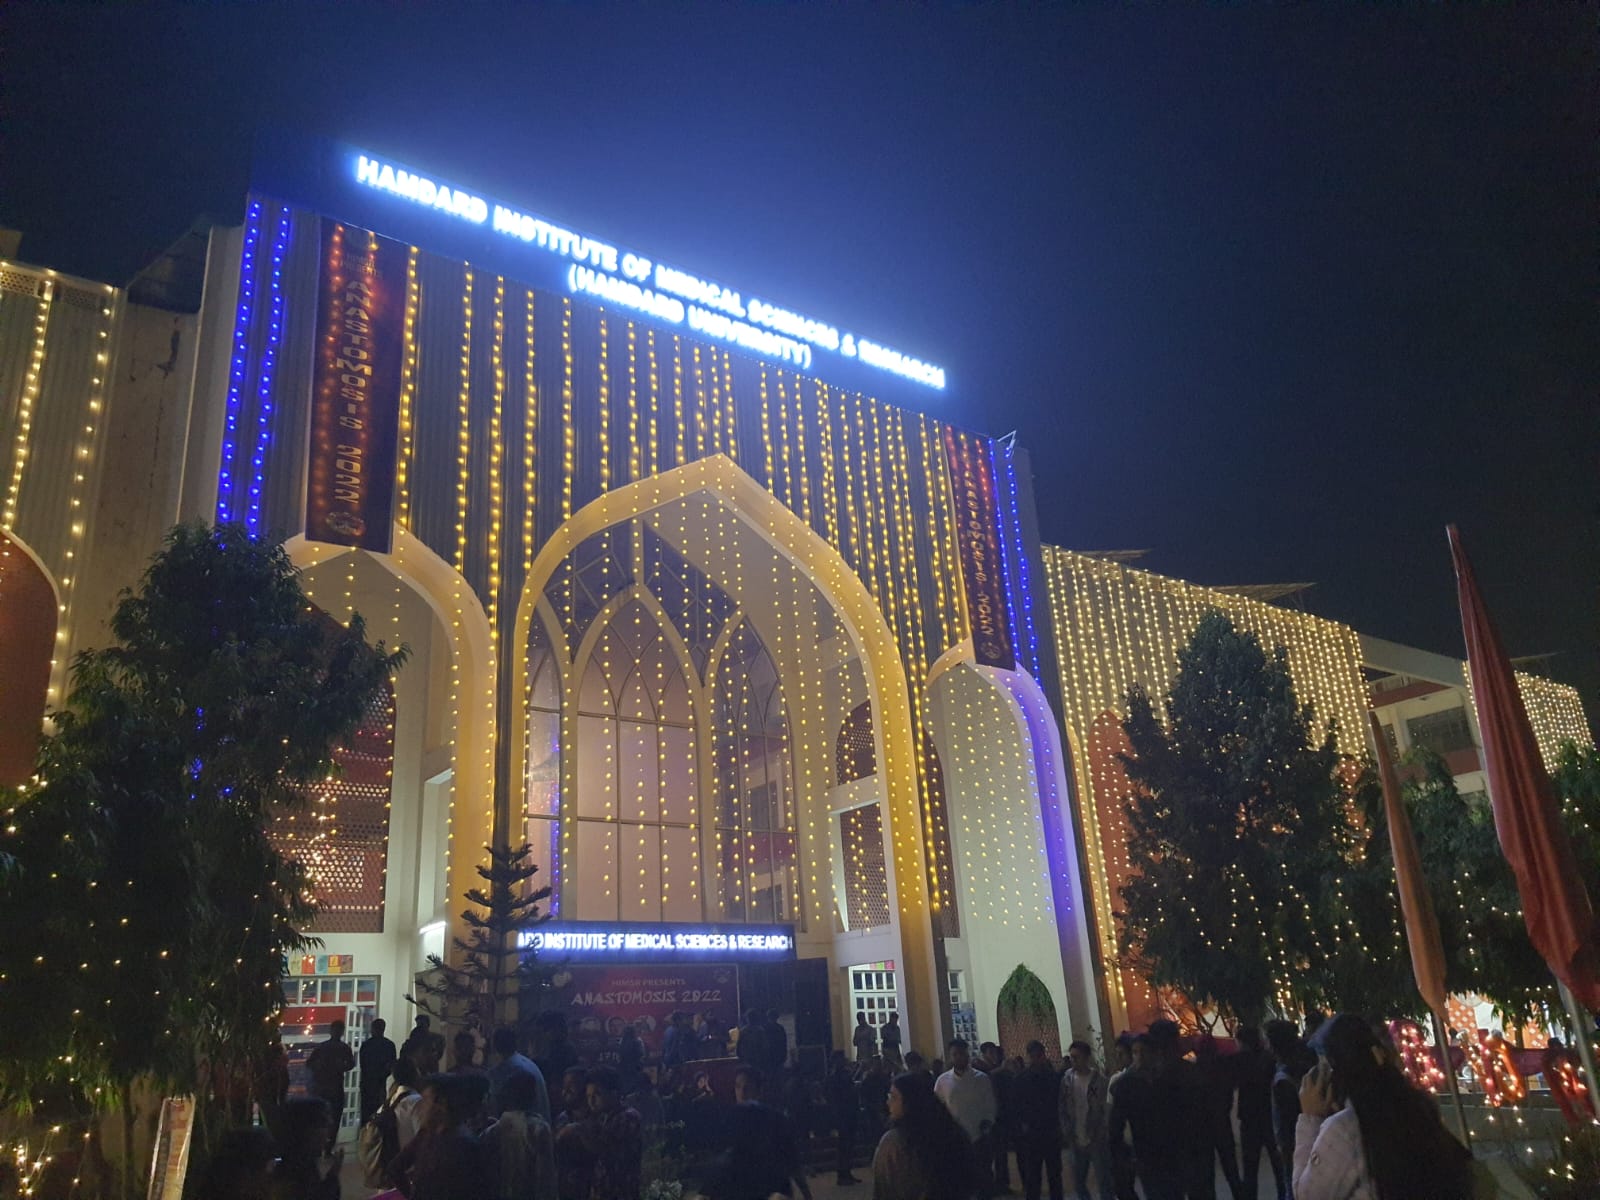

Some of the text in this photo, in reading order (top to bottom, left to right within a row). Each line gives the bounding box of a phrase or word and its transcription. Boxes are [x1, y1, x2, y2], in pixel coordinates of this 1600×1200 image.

[356, 155, 488, 224] HAMDARD
[493, 204, 618, 272] INSTITUTE
[621, 252, 652, 282] OF
[840, 333, 857, 357] &
[544, 932, 607, 950] INSTITUTE
[607, 932, 625, 950] OF
[625, 933, 675, 950] MEDICAL
[675, 932, 728, 950] SCIENCES
[728, 934, 738, 949] &
[737, 934, 793, 950] RESEARCH
[570, 989, 722, 1006] ANASTOMOSIS 2022
